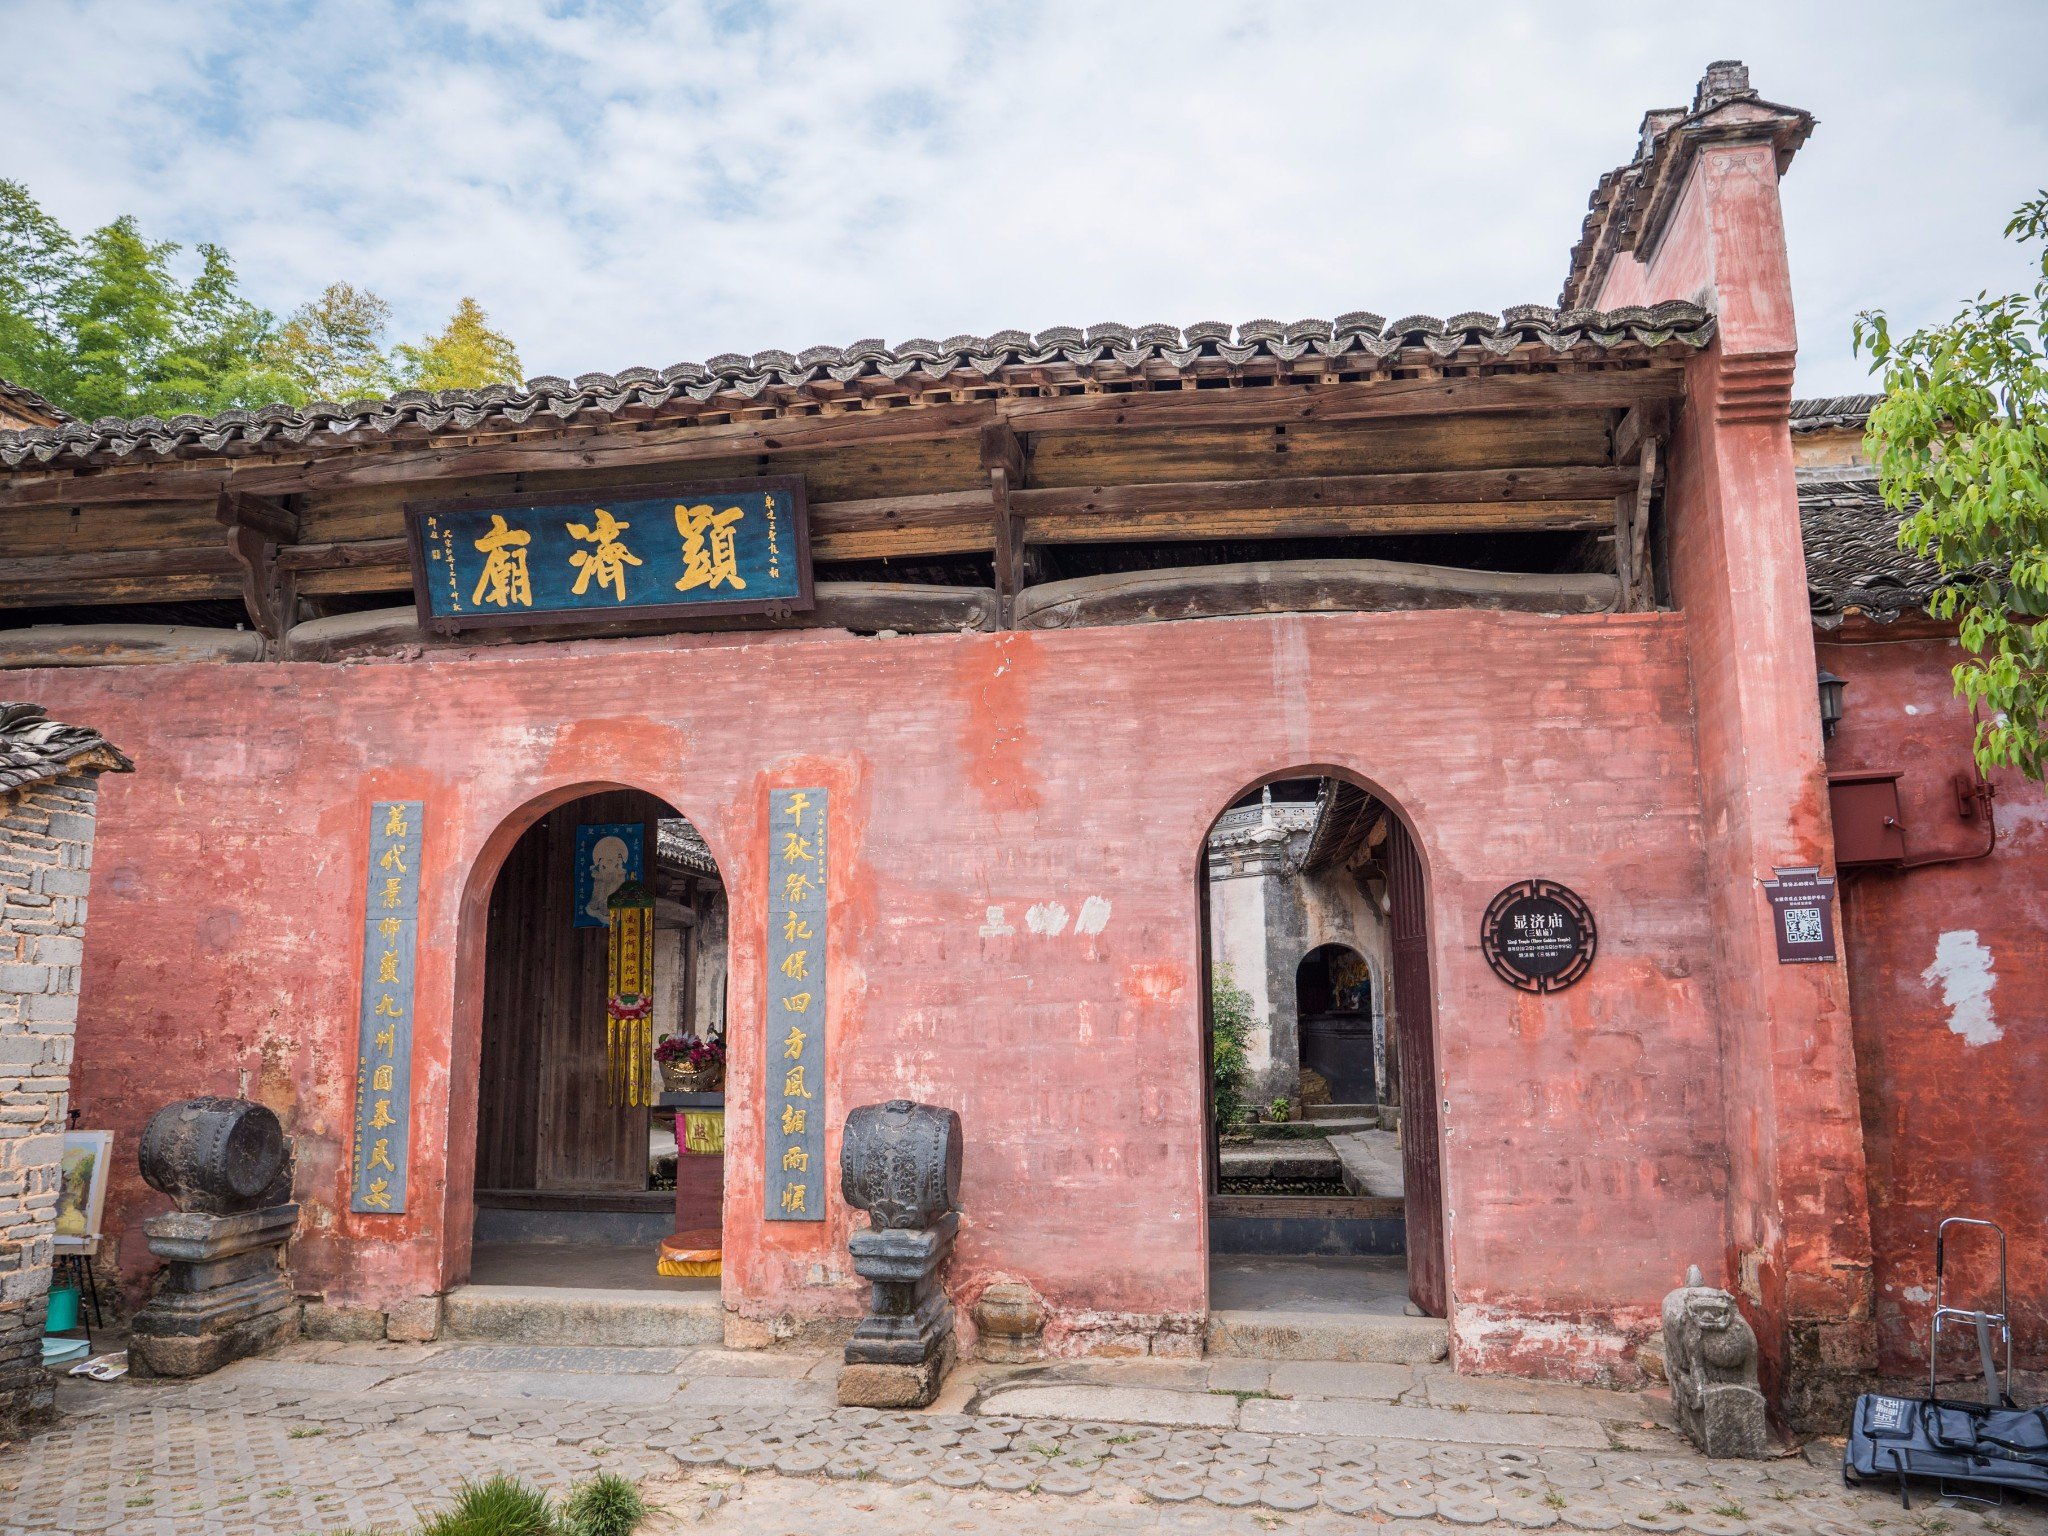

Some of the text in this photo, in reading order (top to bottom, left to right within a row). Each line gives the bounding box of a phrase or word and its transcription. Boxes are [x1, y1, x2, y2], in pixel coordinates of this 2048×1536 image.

[472, 504, 746, 607] 顯濟廟
[1514, 913, 1563, 929] 显济庙
